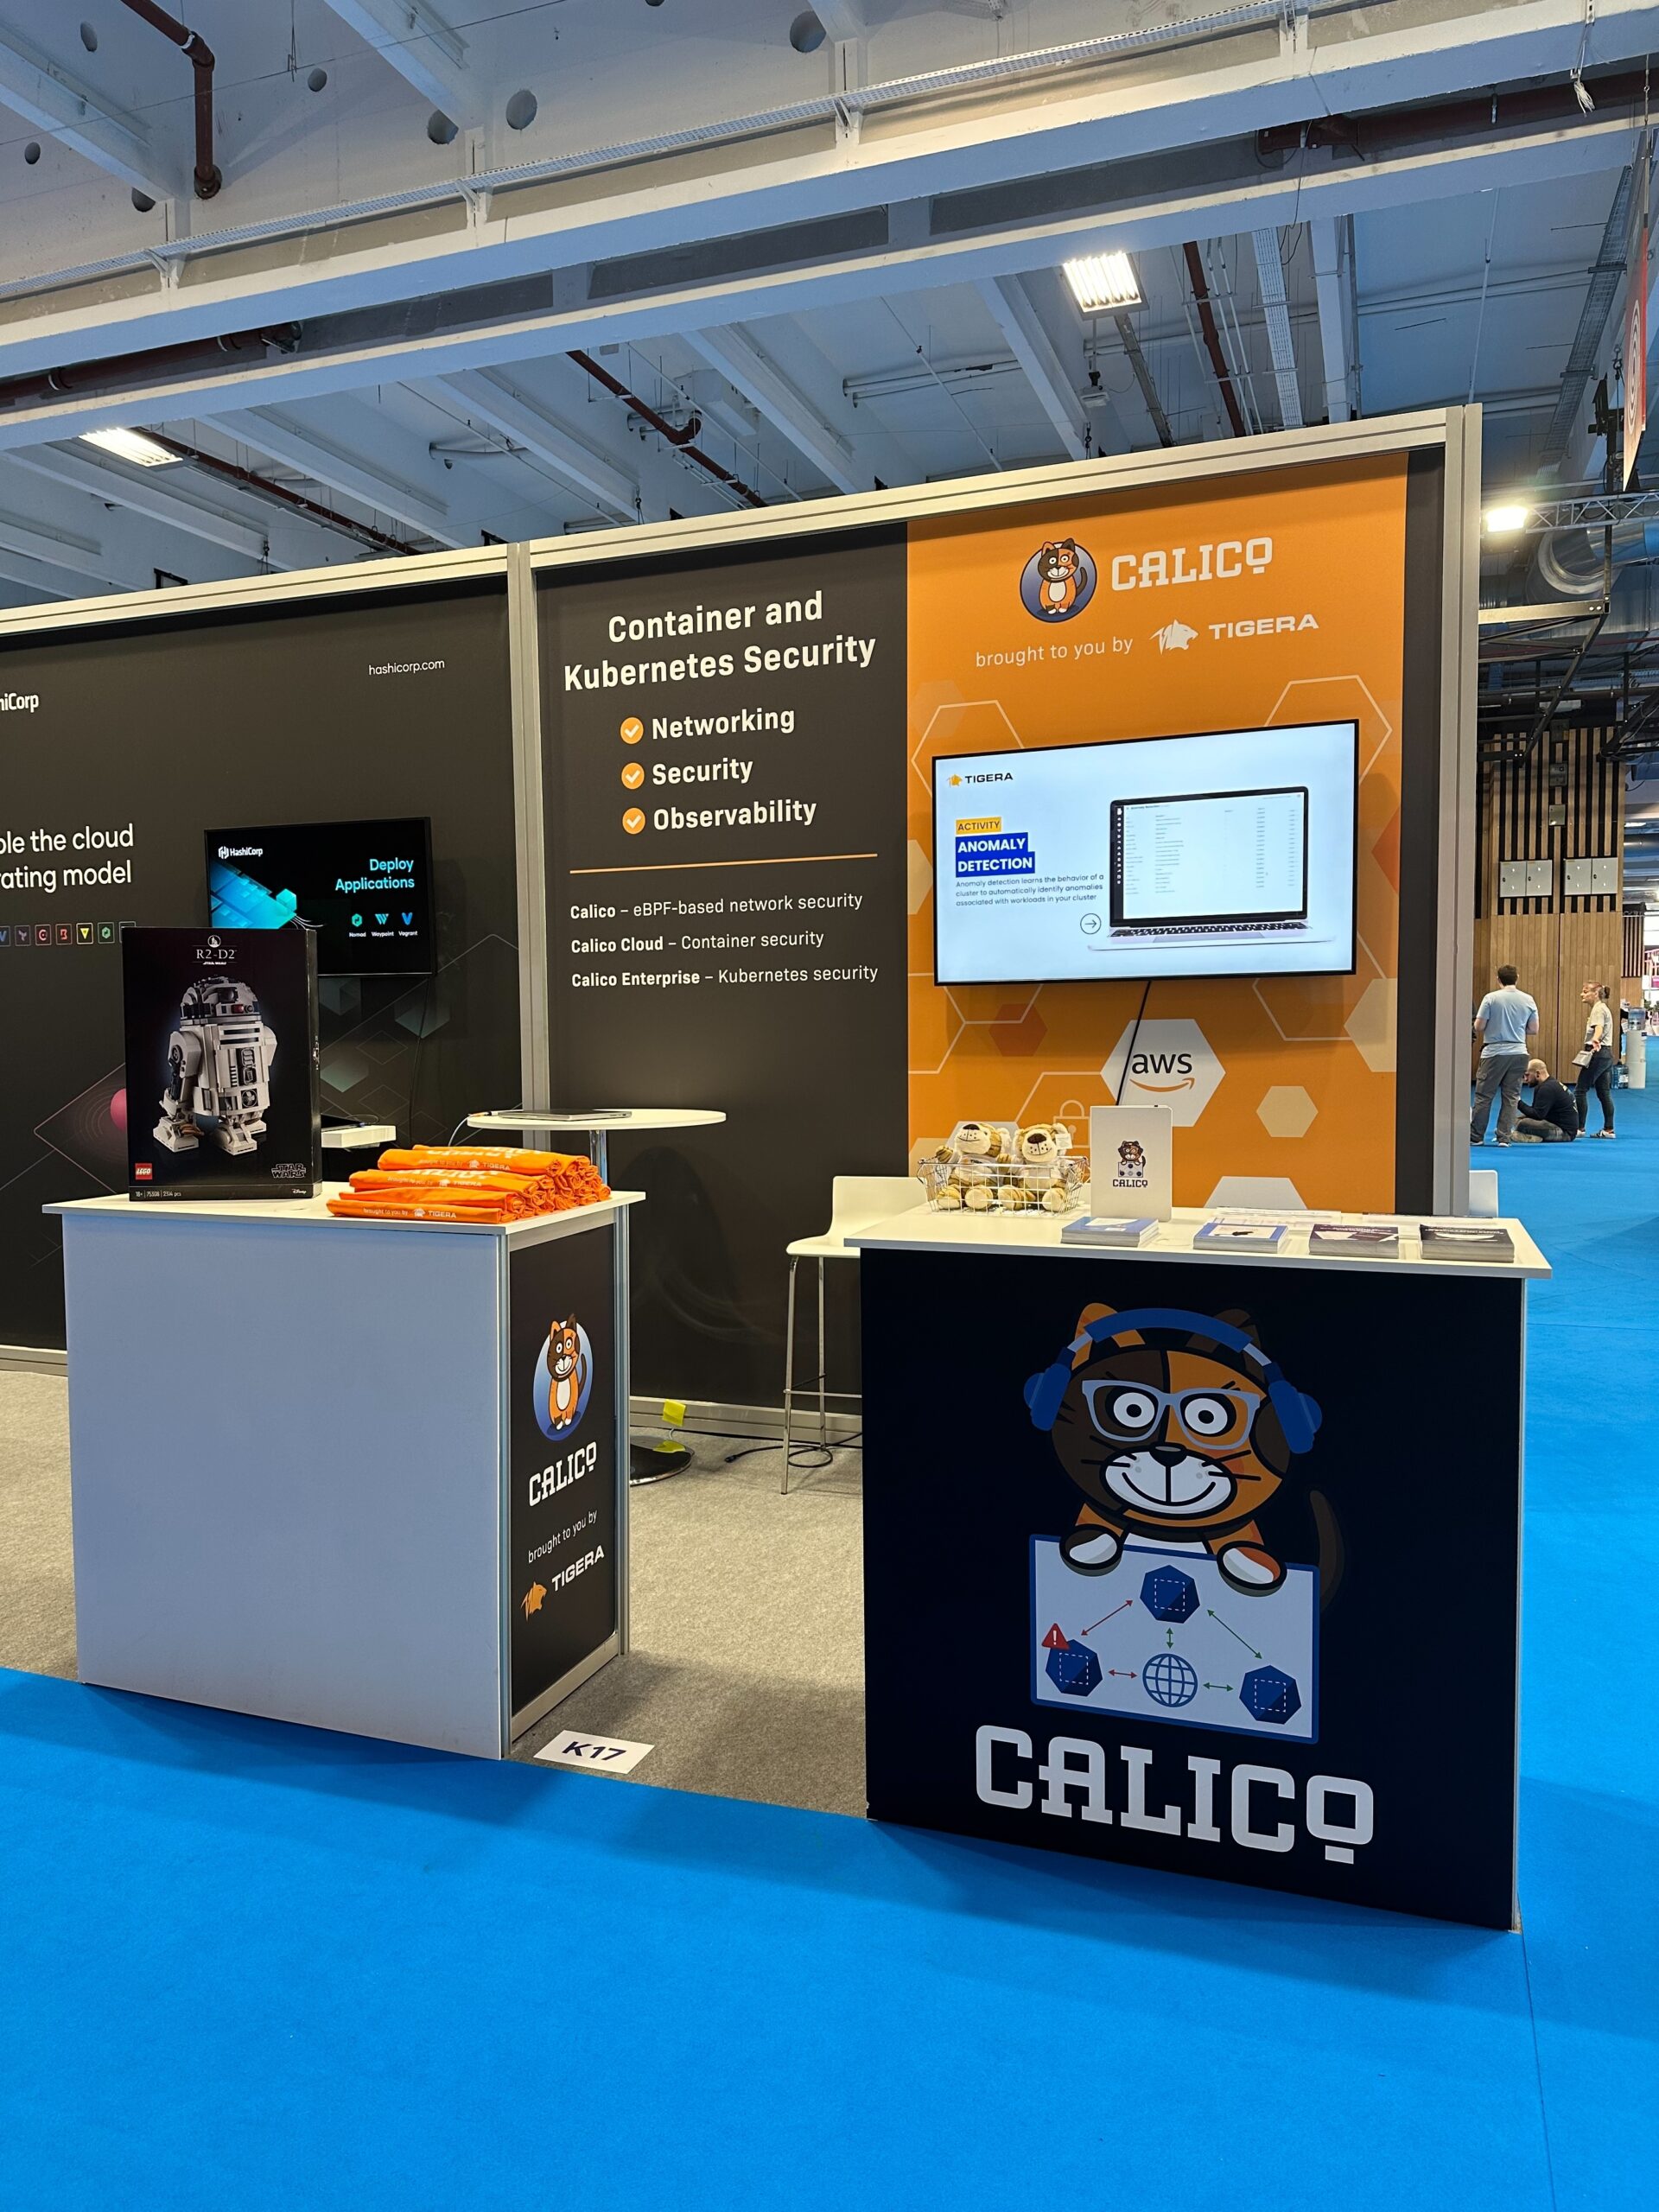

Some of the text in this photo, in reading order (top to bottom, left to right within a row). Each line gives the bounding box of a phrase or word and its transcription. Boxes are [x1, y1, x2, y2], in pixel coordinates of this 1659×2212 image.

[1112, 537, 1273, 591] CALICO
[608, 590, 823, 644] Container and
[976, 613, 1319, 668] brought to you by TIGERA
[368, 658, 445, 676] hashicorp.com
[564, 635, 876, 691] Kubernetes Security
[652, 708, 796, 740] Networking
[652, 758, 753, 786] Security
[965, 772, 1013, 784] TIGERA
[653, 799, 817, 831] Observability
[957, 821, 1000, 831] ACTIVITY
[29, 828, 67, 852] the
[72, 823, 134, 850] cloud
[957, 838, 1026, 853] ANOMALY
[230, 848, 263, 857] HashiCorp
[0, 859, 131, 893] ating model
[369, 857, 414, 873] Deploy
[957, 857, 1033, 873] DETECTION
[335, 876, 415, 893] Applications
[1038, 885, 1064, 893] identify
[570, 905, 616, 919] Calico
[633, 899, 724, 918] eBPF-based
[729, 894, 793, 912] network
[798, 893, 863, 912] security
[1055, 896, 1071, 905] your
[195, 949, 235, 959] R2-D2
[571, 939, 617, 954] Calico
[620, 936, 664, 952] Cloud
[681, 934, 756, 950] Container
[760, 931, 824, 950] security
[571, 973, 618, 987] Calico
[621, 969, 701, 988] Enterprise
[718, 968, 809, 984] Kubernetes
[813, 964, 878, 983] security
[1131, 1052, 1192, 1075] aws
[271, 1170, 306, 1179] WARS
[529, 1441, 598, 1507] CALICO
[528, 1510, 598, 1563] brought to you by
[552, 1550, 605, 1592] TIGERA
[563, 1741, 627, 1763] K17
[976, 1725, 1374, 1865] CALICO
